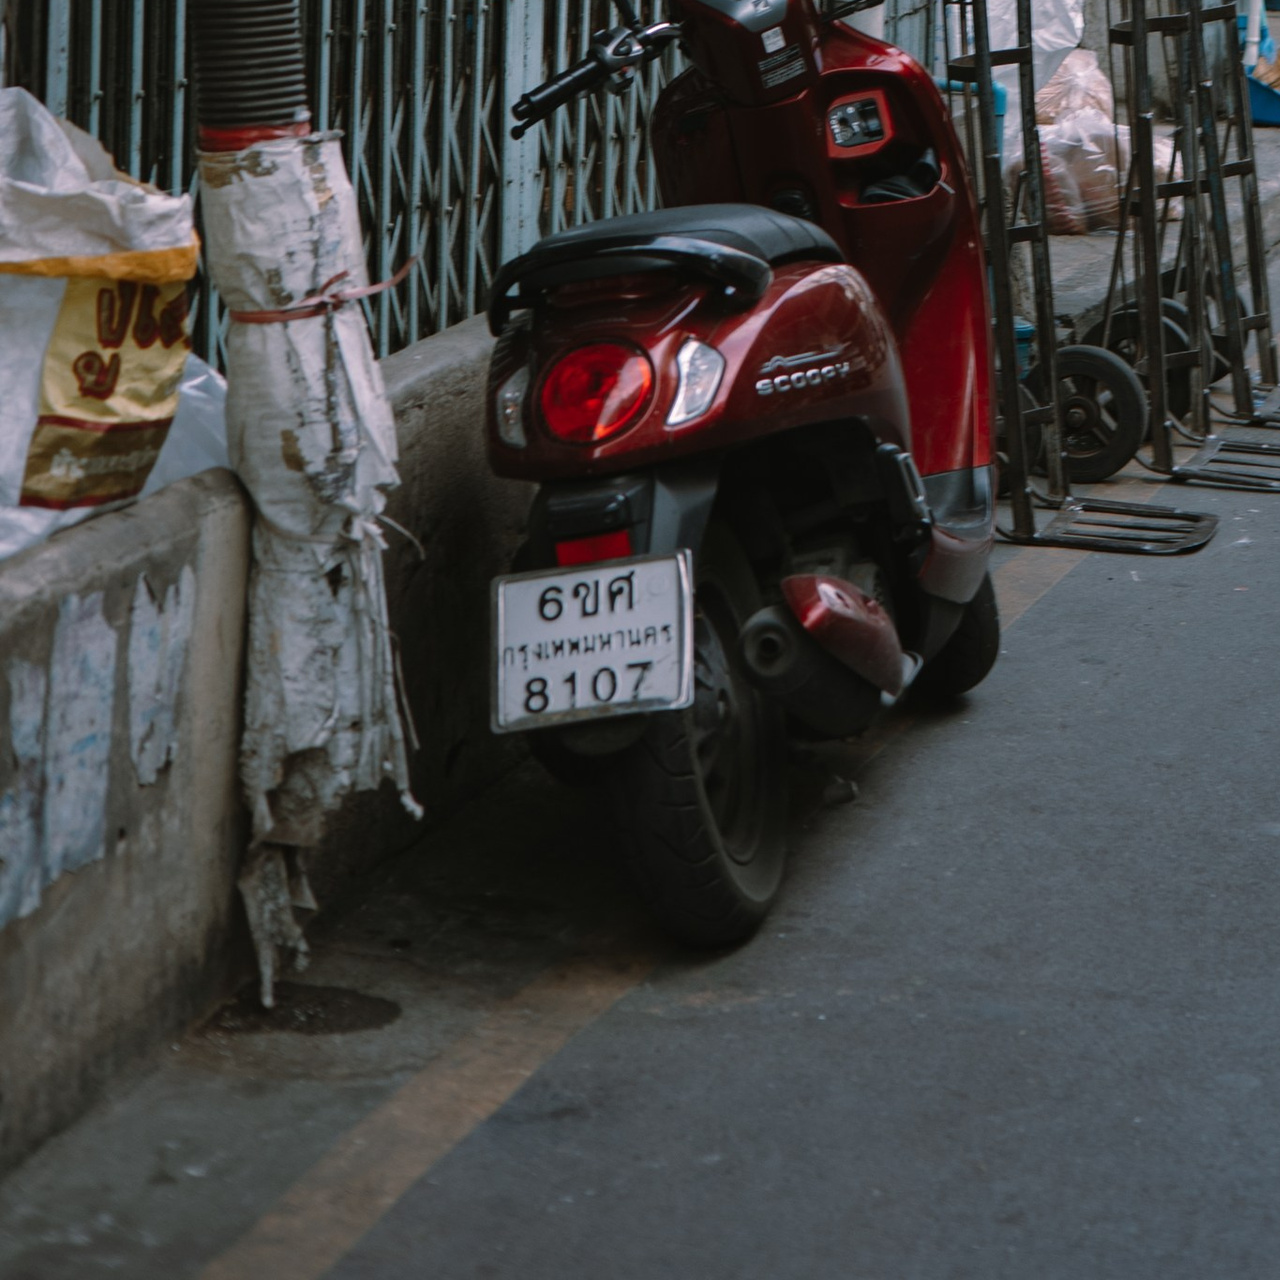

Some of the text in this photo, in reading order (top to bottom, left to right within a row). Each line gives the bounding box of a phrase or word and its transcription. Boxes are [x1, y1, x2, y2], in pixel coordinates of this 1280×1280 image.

[755, 361, 850, 396] SCOOPY
[538, 570, 636, 622] 6ขศ
[503, 624, 672, 670] กรุงเทพมหานคร
[524, 661, 653, 714] 8107
